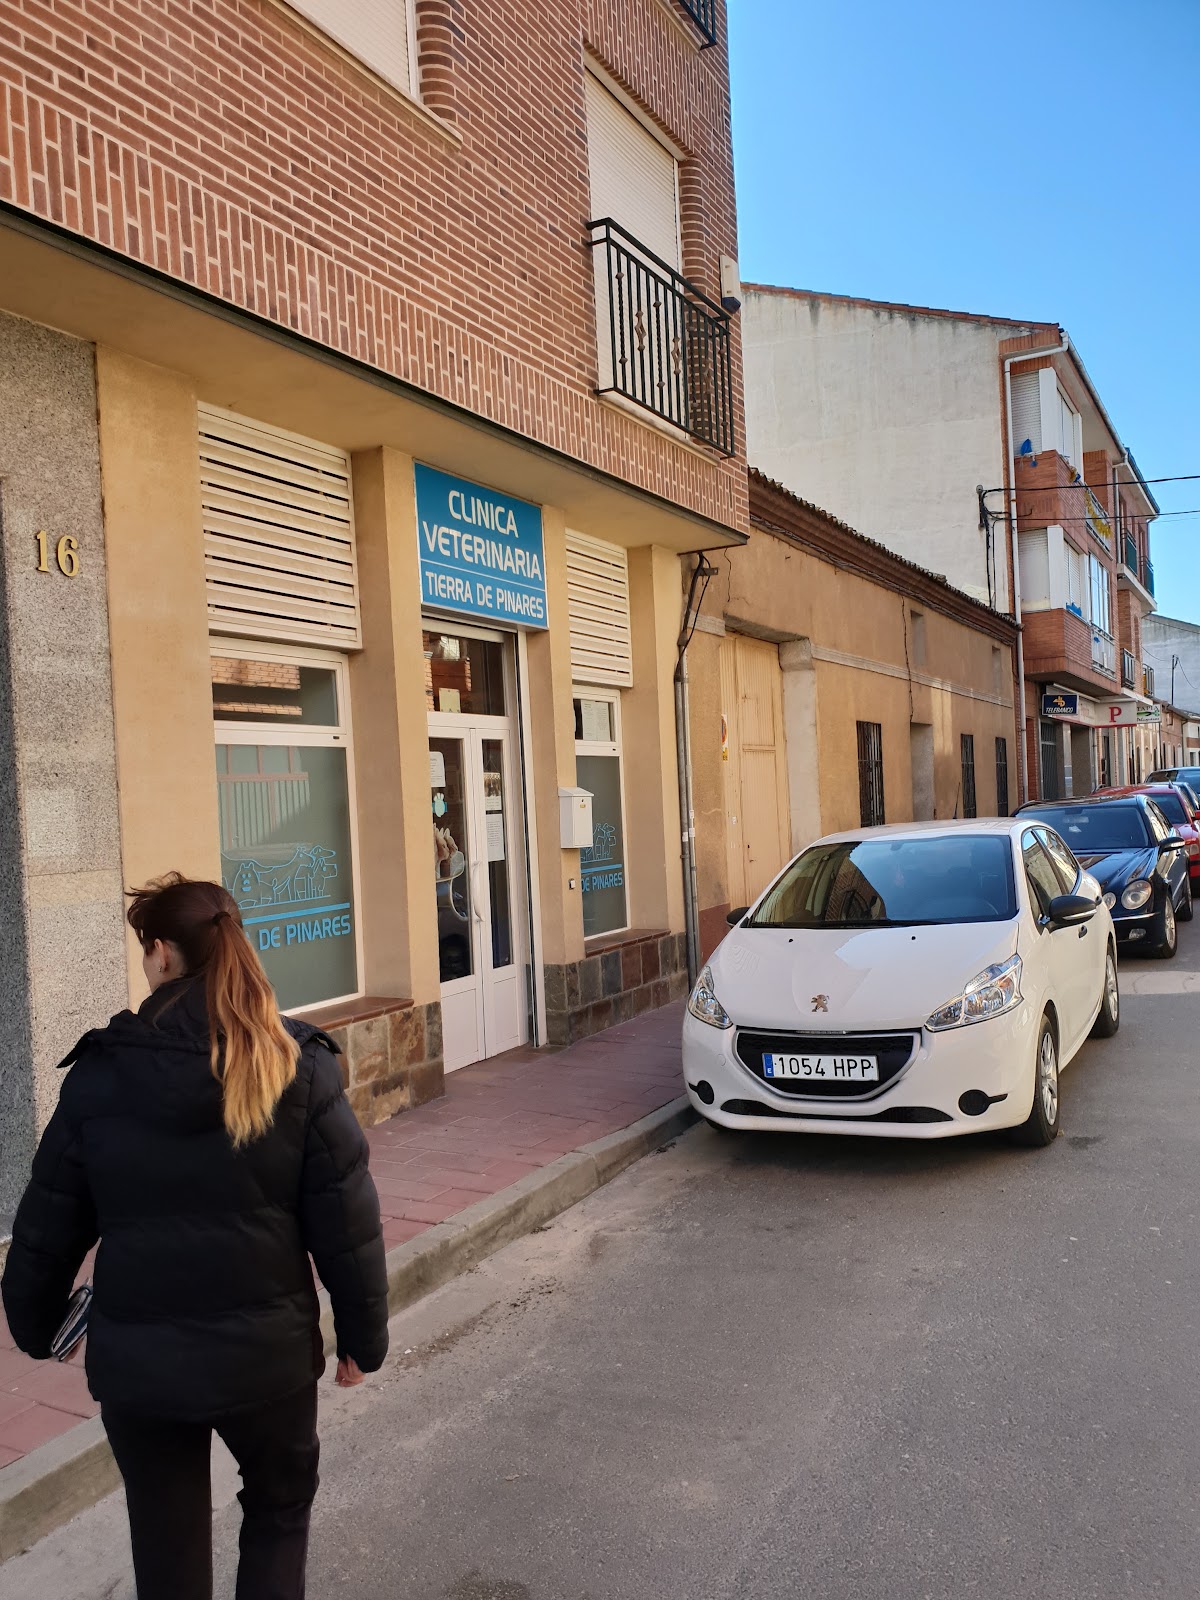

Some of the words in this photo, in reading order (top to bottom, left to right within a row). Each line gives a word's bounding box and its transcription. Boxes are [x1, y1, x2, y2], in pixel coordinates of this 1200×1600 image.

[448, 490, 519, 538] CLINICA
[35, 530, 80, 577] 16
[422, 520, 543, 581] VETERINARIA
[425, 571, 473, 604] TIERRA
[476, 582, 493, 608] DE
[496, 588, 544, 619] PINARES
[1109, 706, 1122, 723] P
[592, 872, 623, 890] PINARES
[259, 926, 281, 950] DE
[286, 914, 351, 945] PINARES
[779, 1057, 826, 1076] 1054
[833, 1058, 872, 1077] HPP
